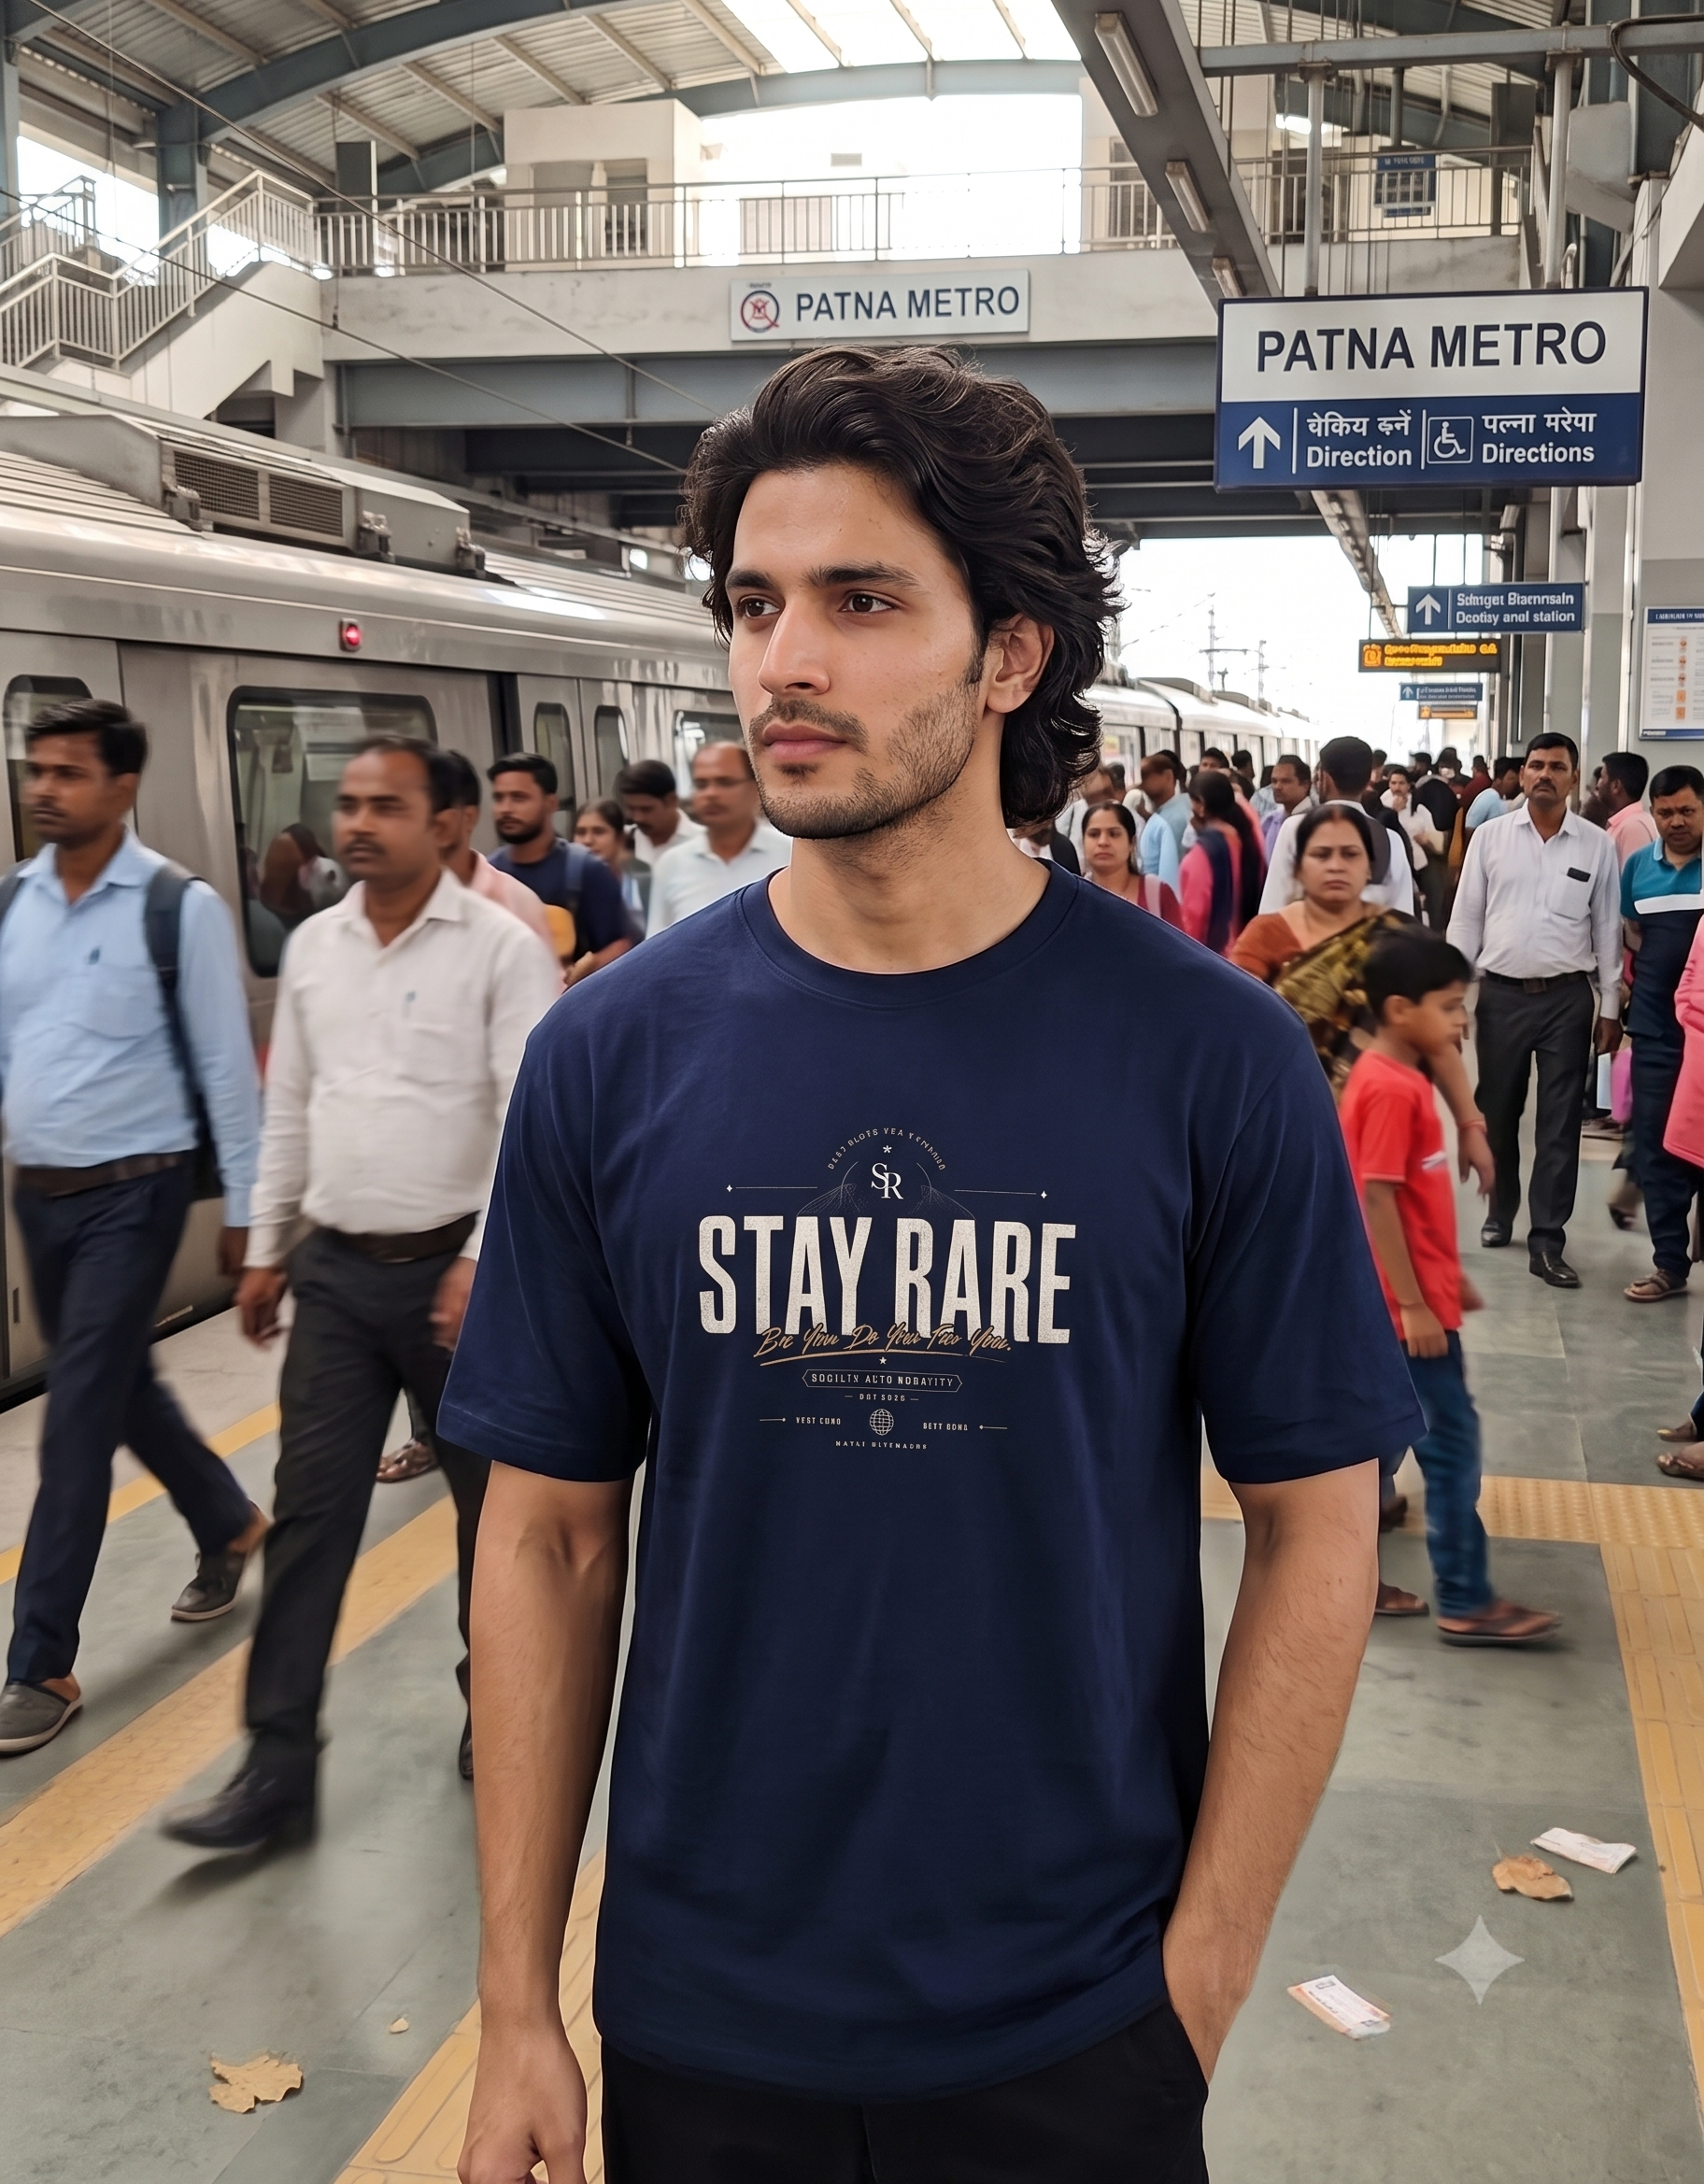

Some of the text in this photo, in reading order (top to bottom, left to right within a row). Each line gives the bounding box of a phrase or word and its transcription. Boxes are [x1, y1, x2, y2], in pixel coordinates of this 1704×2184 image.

[796, 286, 1020, 321] PATNA METRO
[1257, 320, 1607, 373] PATNA METRO
[1306, 444, 1413, 468] Direction
[1482, 441, 1596, 463] Directions
[1532, 610, 1576, 623] station
[699, 1215, 1076, 1344] STAY RARE
